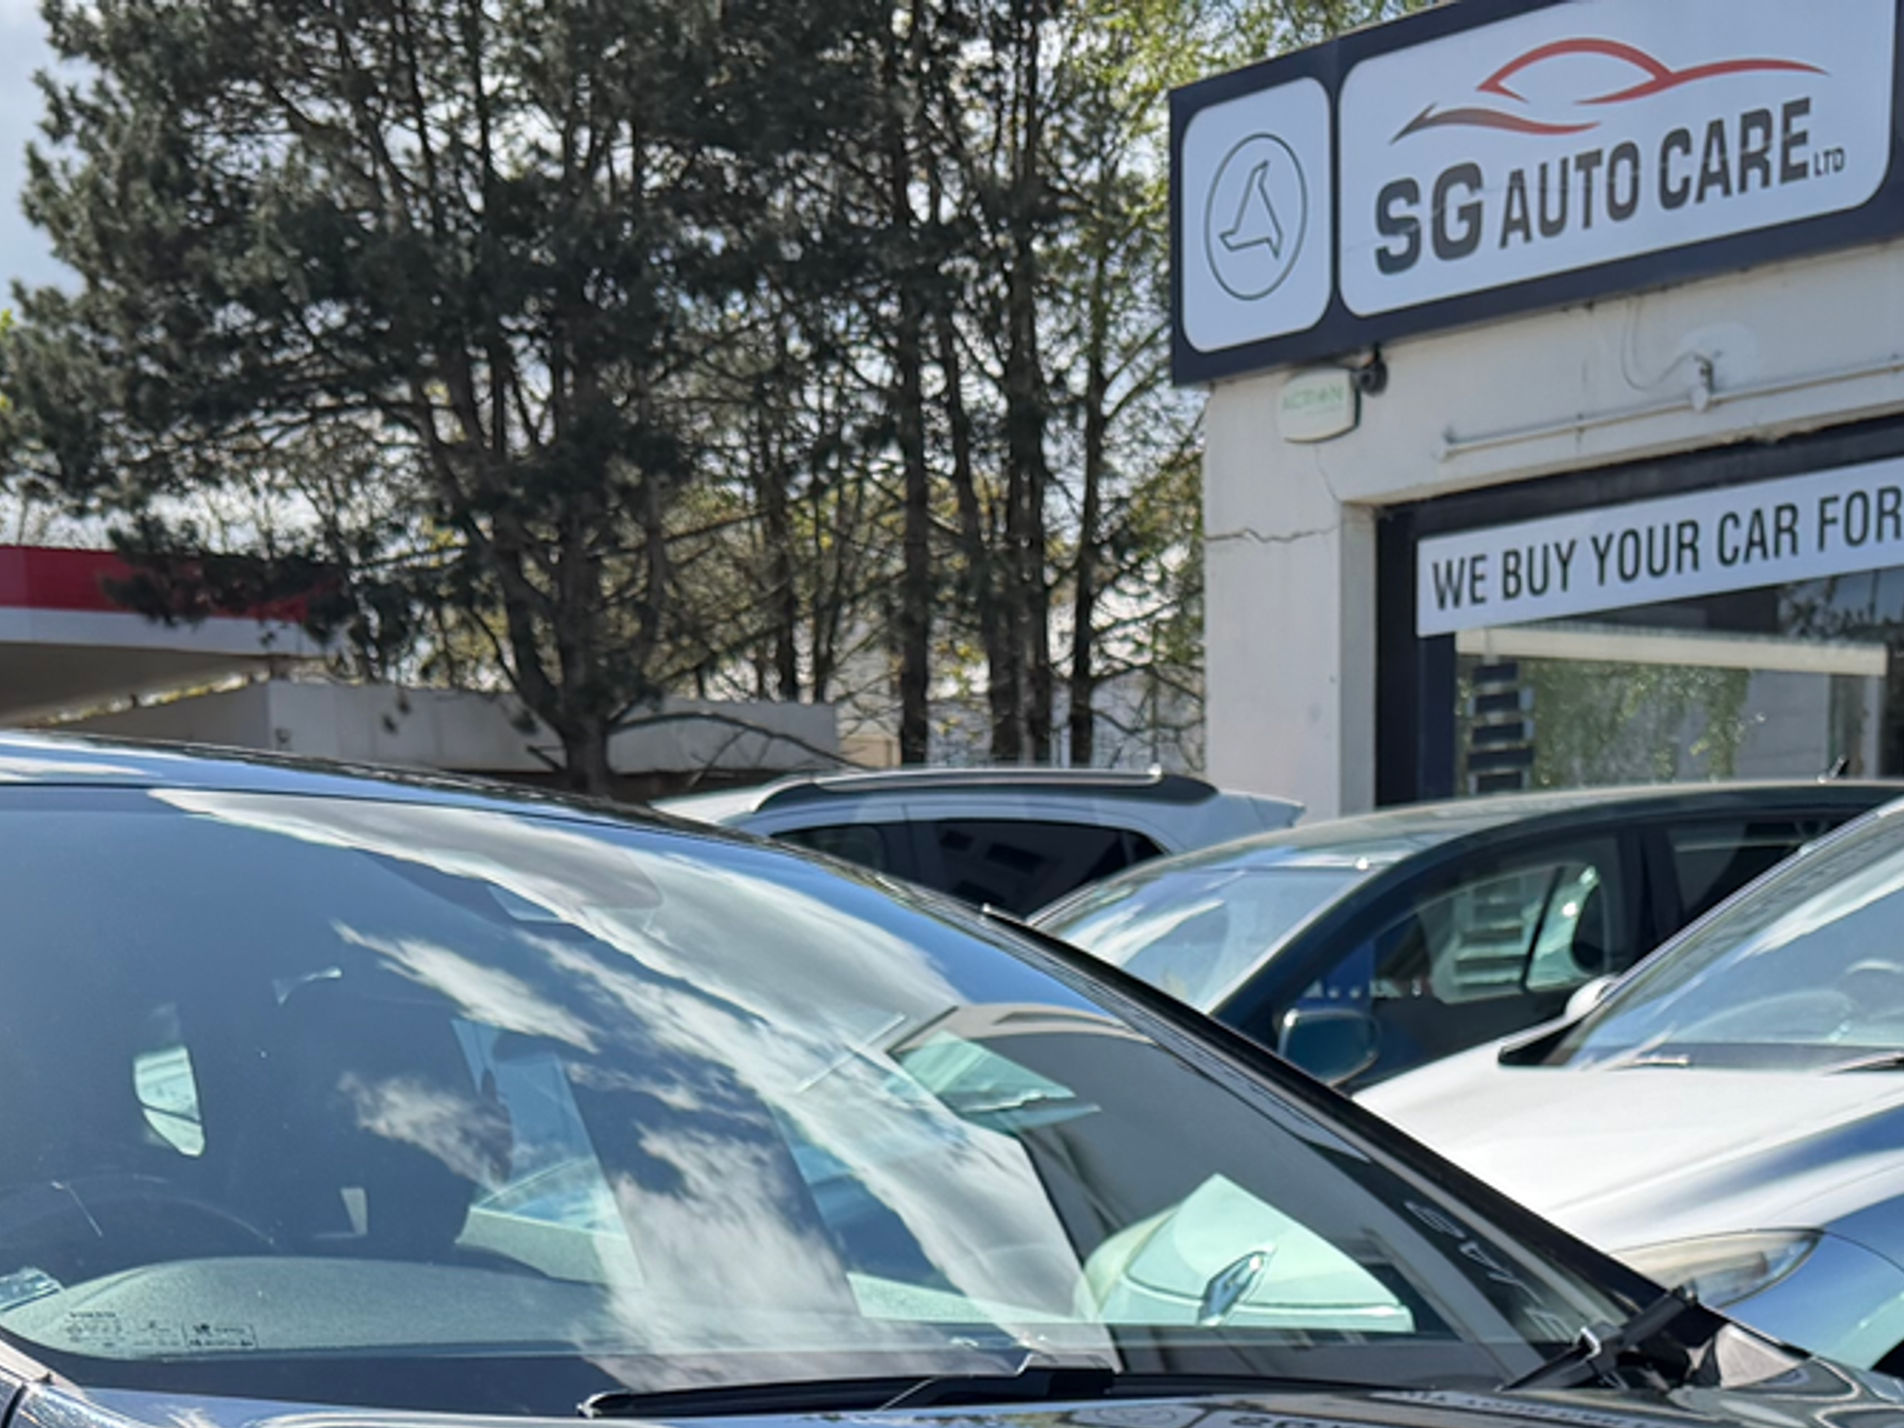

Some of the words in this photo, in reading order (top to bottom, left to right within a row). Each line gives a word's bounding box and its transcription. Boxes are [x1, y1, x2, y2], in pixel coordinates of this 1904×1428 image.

[1375, 161, 1484, 276] SG
[1499, 141, 1640, 250] AUTO
[1658, 97, 1812, 211] CARE
[1813, 147, 1846, 177] LTD
[1433, 553, 1488, 611] WE
[1502, 540, 1577, 600] BUY
[1591, 519, 1700, 587] YOUR
[1716, 502, 1800, 566] CAR
[1816, 486, 1903, 552] FOR
